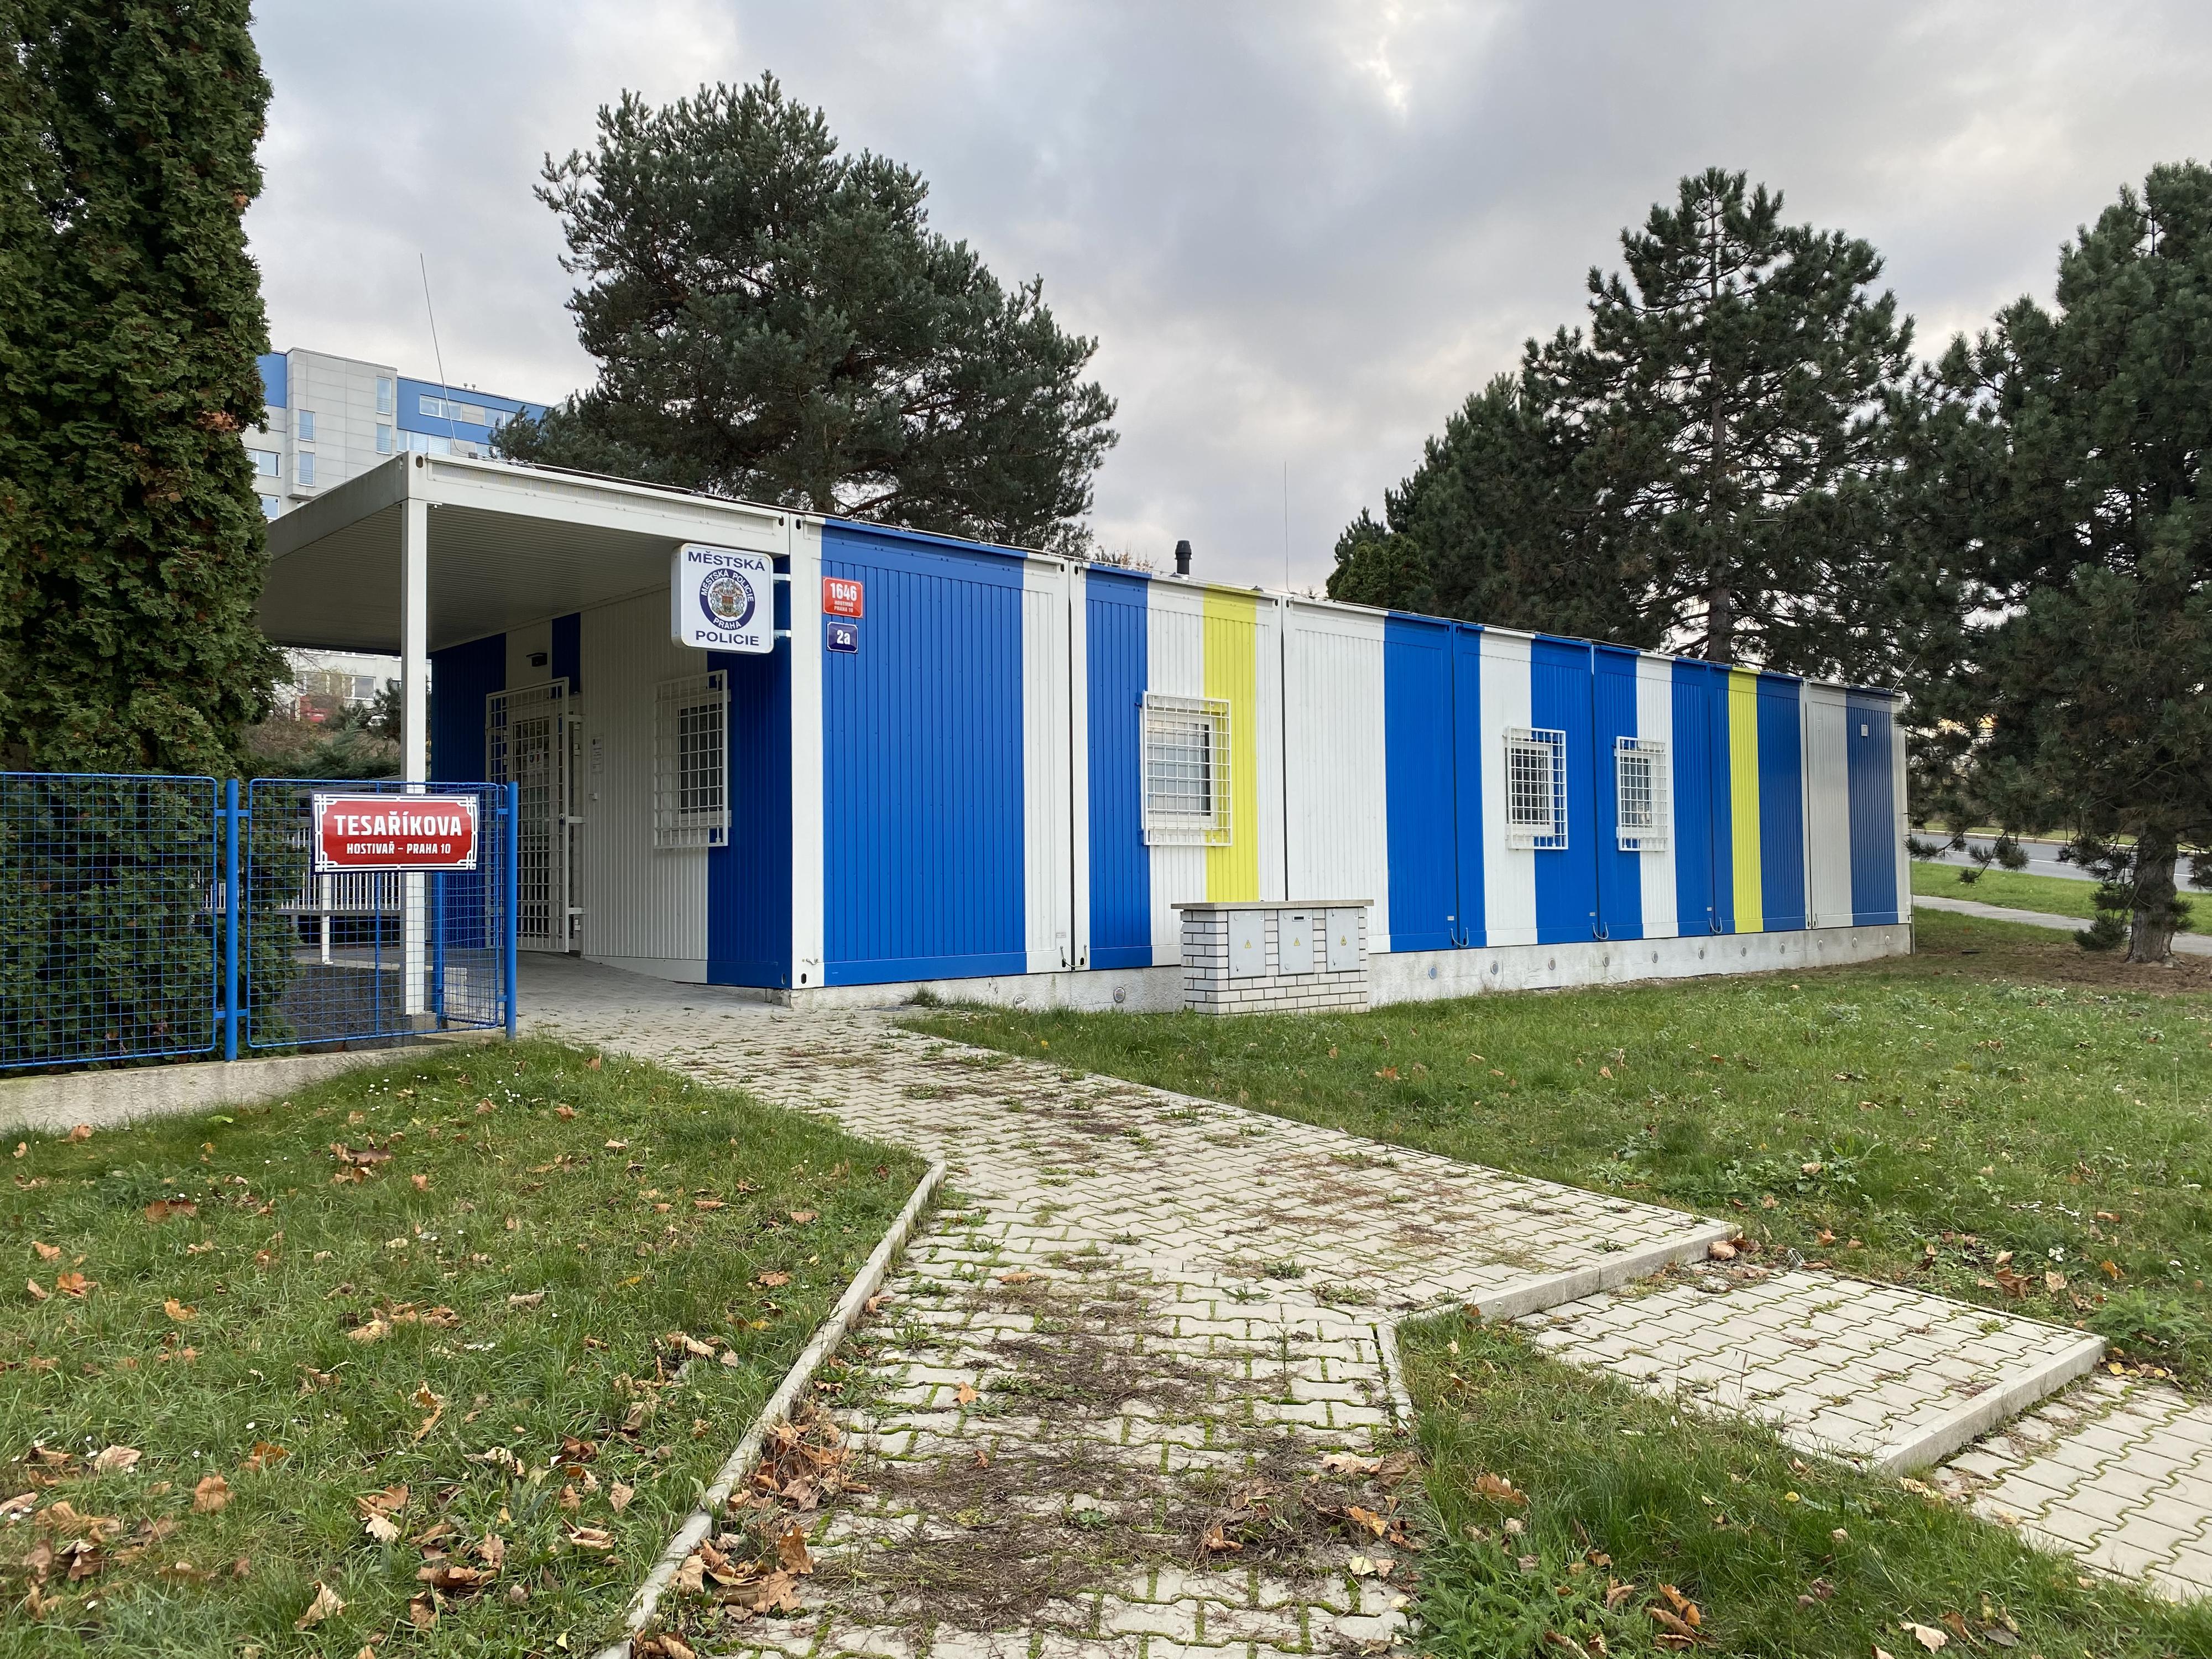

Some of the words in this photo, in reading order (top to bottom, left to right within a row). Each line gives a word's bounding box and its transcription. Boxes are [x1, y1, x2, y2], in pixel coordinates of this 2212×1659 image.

[688, 550, 765, 571] MĚSTSKÁ
[732, 572, 754, 602] POLICIE
[830, 582, 857, 601] 1646
[713, 617, 742, 629] PRAHA
[696, 630, 759, 646] POLICIE
[837, 629, 851, 645] 2a
[333, 811, 462, 836] TESAŘÍKOVA
[346, 841, 394, 854] HOSTIVAŘ
[406, 843, 437, 854] PRAHA
[441, 843, 451, 854] 10
